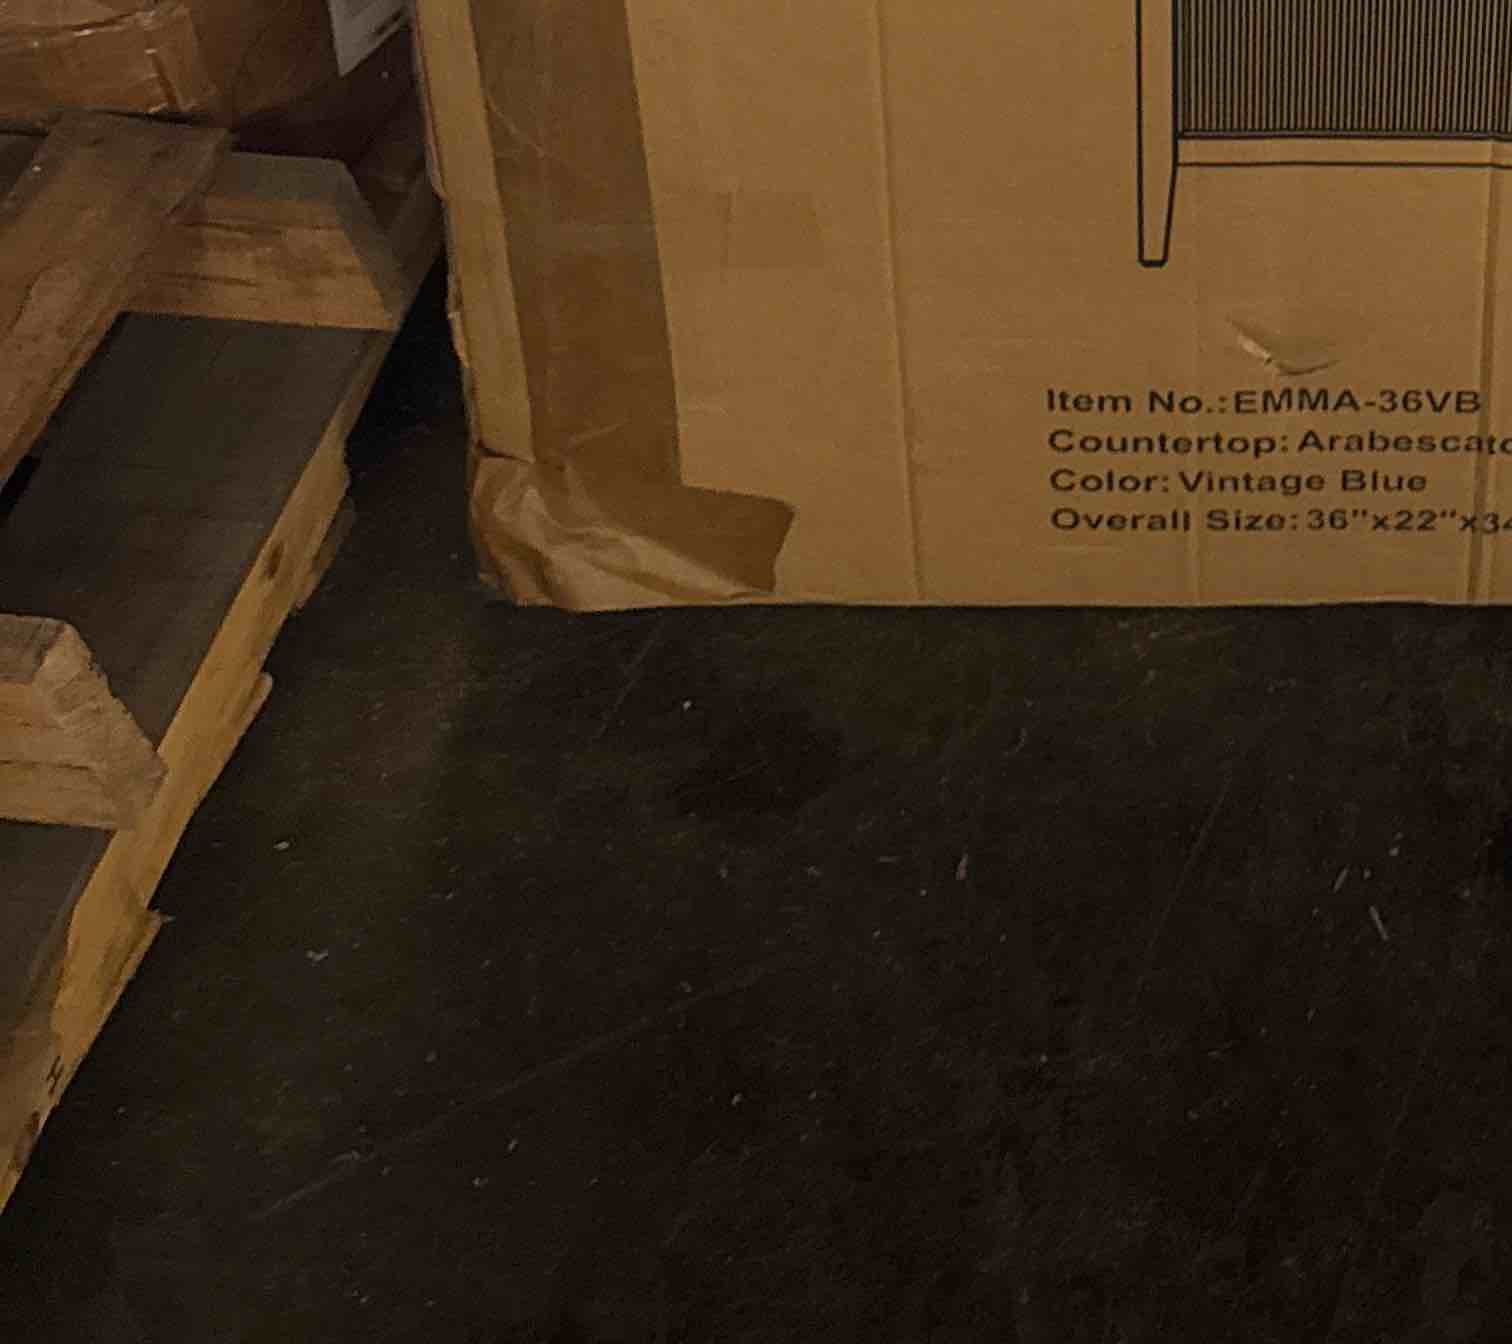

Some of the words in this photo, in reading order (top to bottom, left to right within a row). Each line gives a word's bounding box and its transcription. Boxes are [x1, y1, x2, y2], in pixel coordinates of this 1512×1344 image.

[1046, 388, 1132, 413] Item
[1341, 469, 1427, 493] Blue
[1050, 507, 1191, 533] Overall
